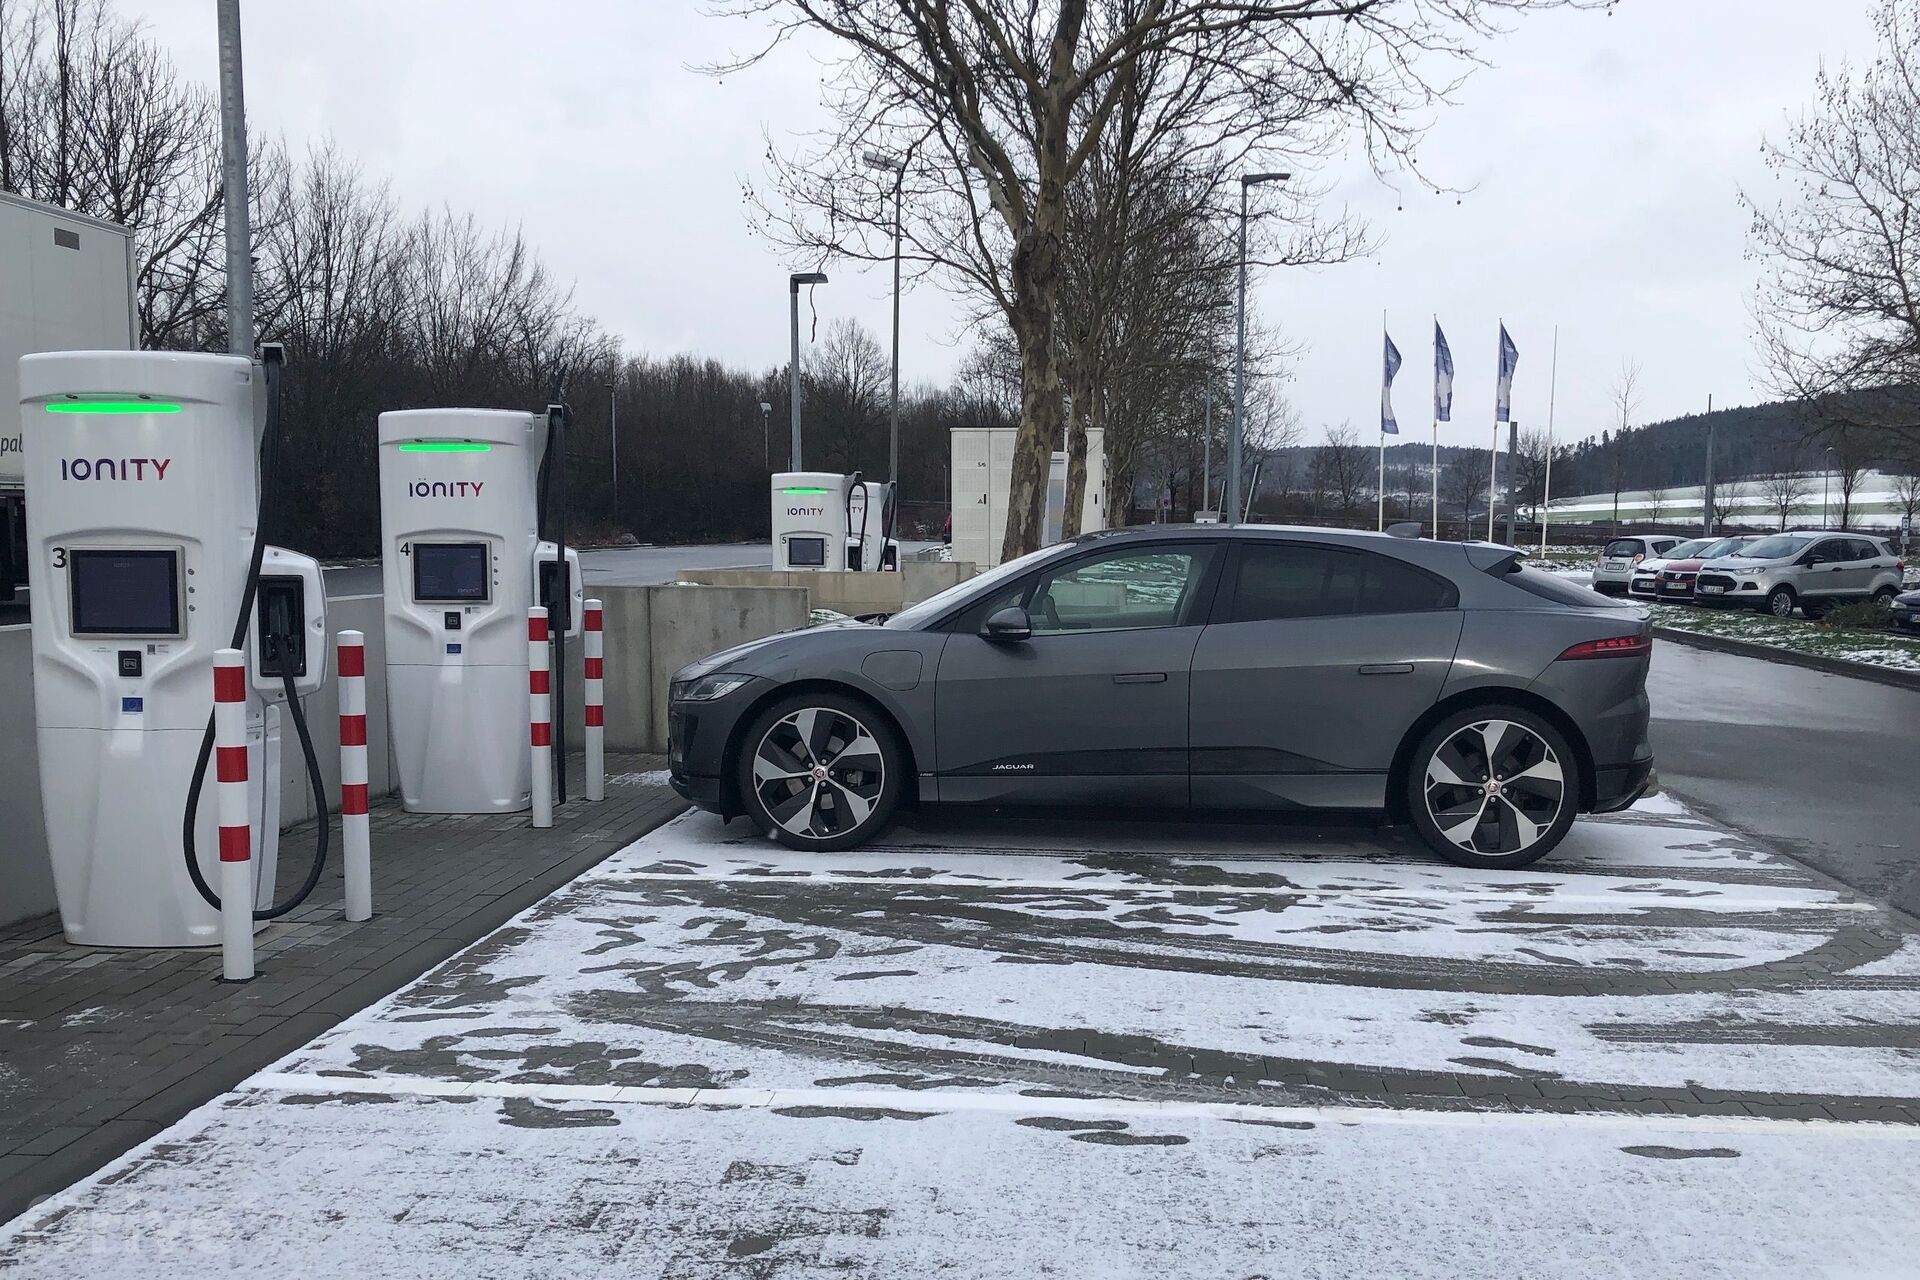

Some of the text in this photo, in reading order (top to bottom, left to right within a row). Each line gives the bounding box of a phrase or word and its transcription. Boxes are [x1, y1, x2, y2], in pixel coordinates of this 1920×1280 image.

[61, 458, 171, 481] IONITY
[787, 507, 824, 516] IONITY
[781, 536, 787, 545] 5
[400, 541, 411, 556] 4
[52, 547, 67, 569] 3
